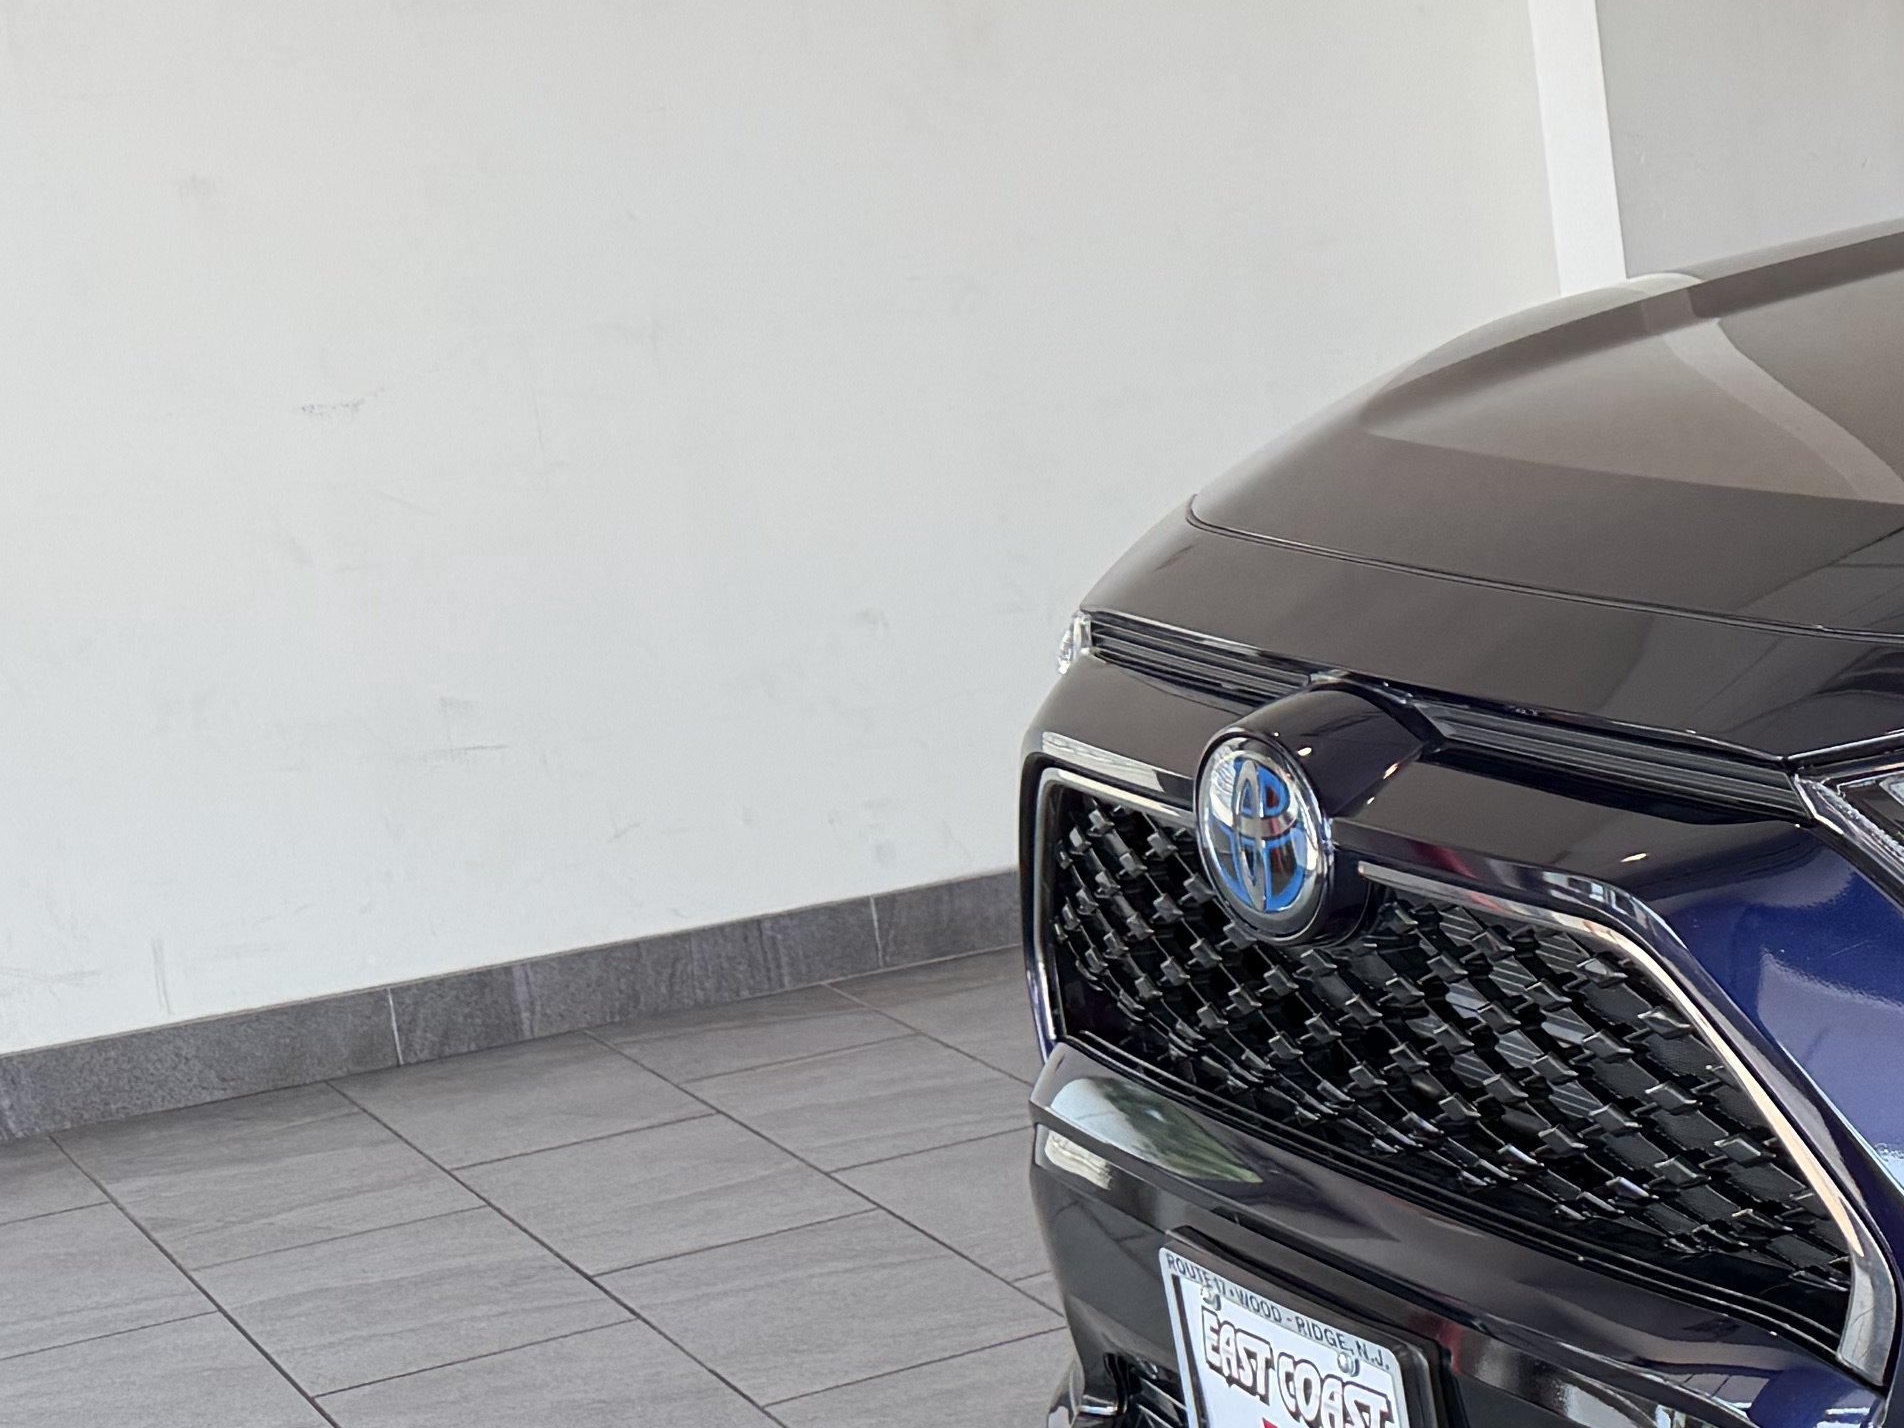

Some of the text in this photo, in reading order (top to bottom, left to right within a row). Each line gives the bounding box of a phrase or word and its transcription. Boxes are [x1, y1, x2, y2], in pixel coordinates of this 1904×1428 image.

[1166, 1253, 1214, 1289] ROUTE
[1236, 1289, 1282, 1323] WOOD
[1357, 1340, 1390, 1370] N.J.
[1202, 1306, 1273, 1405] EAST
